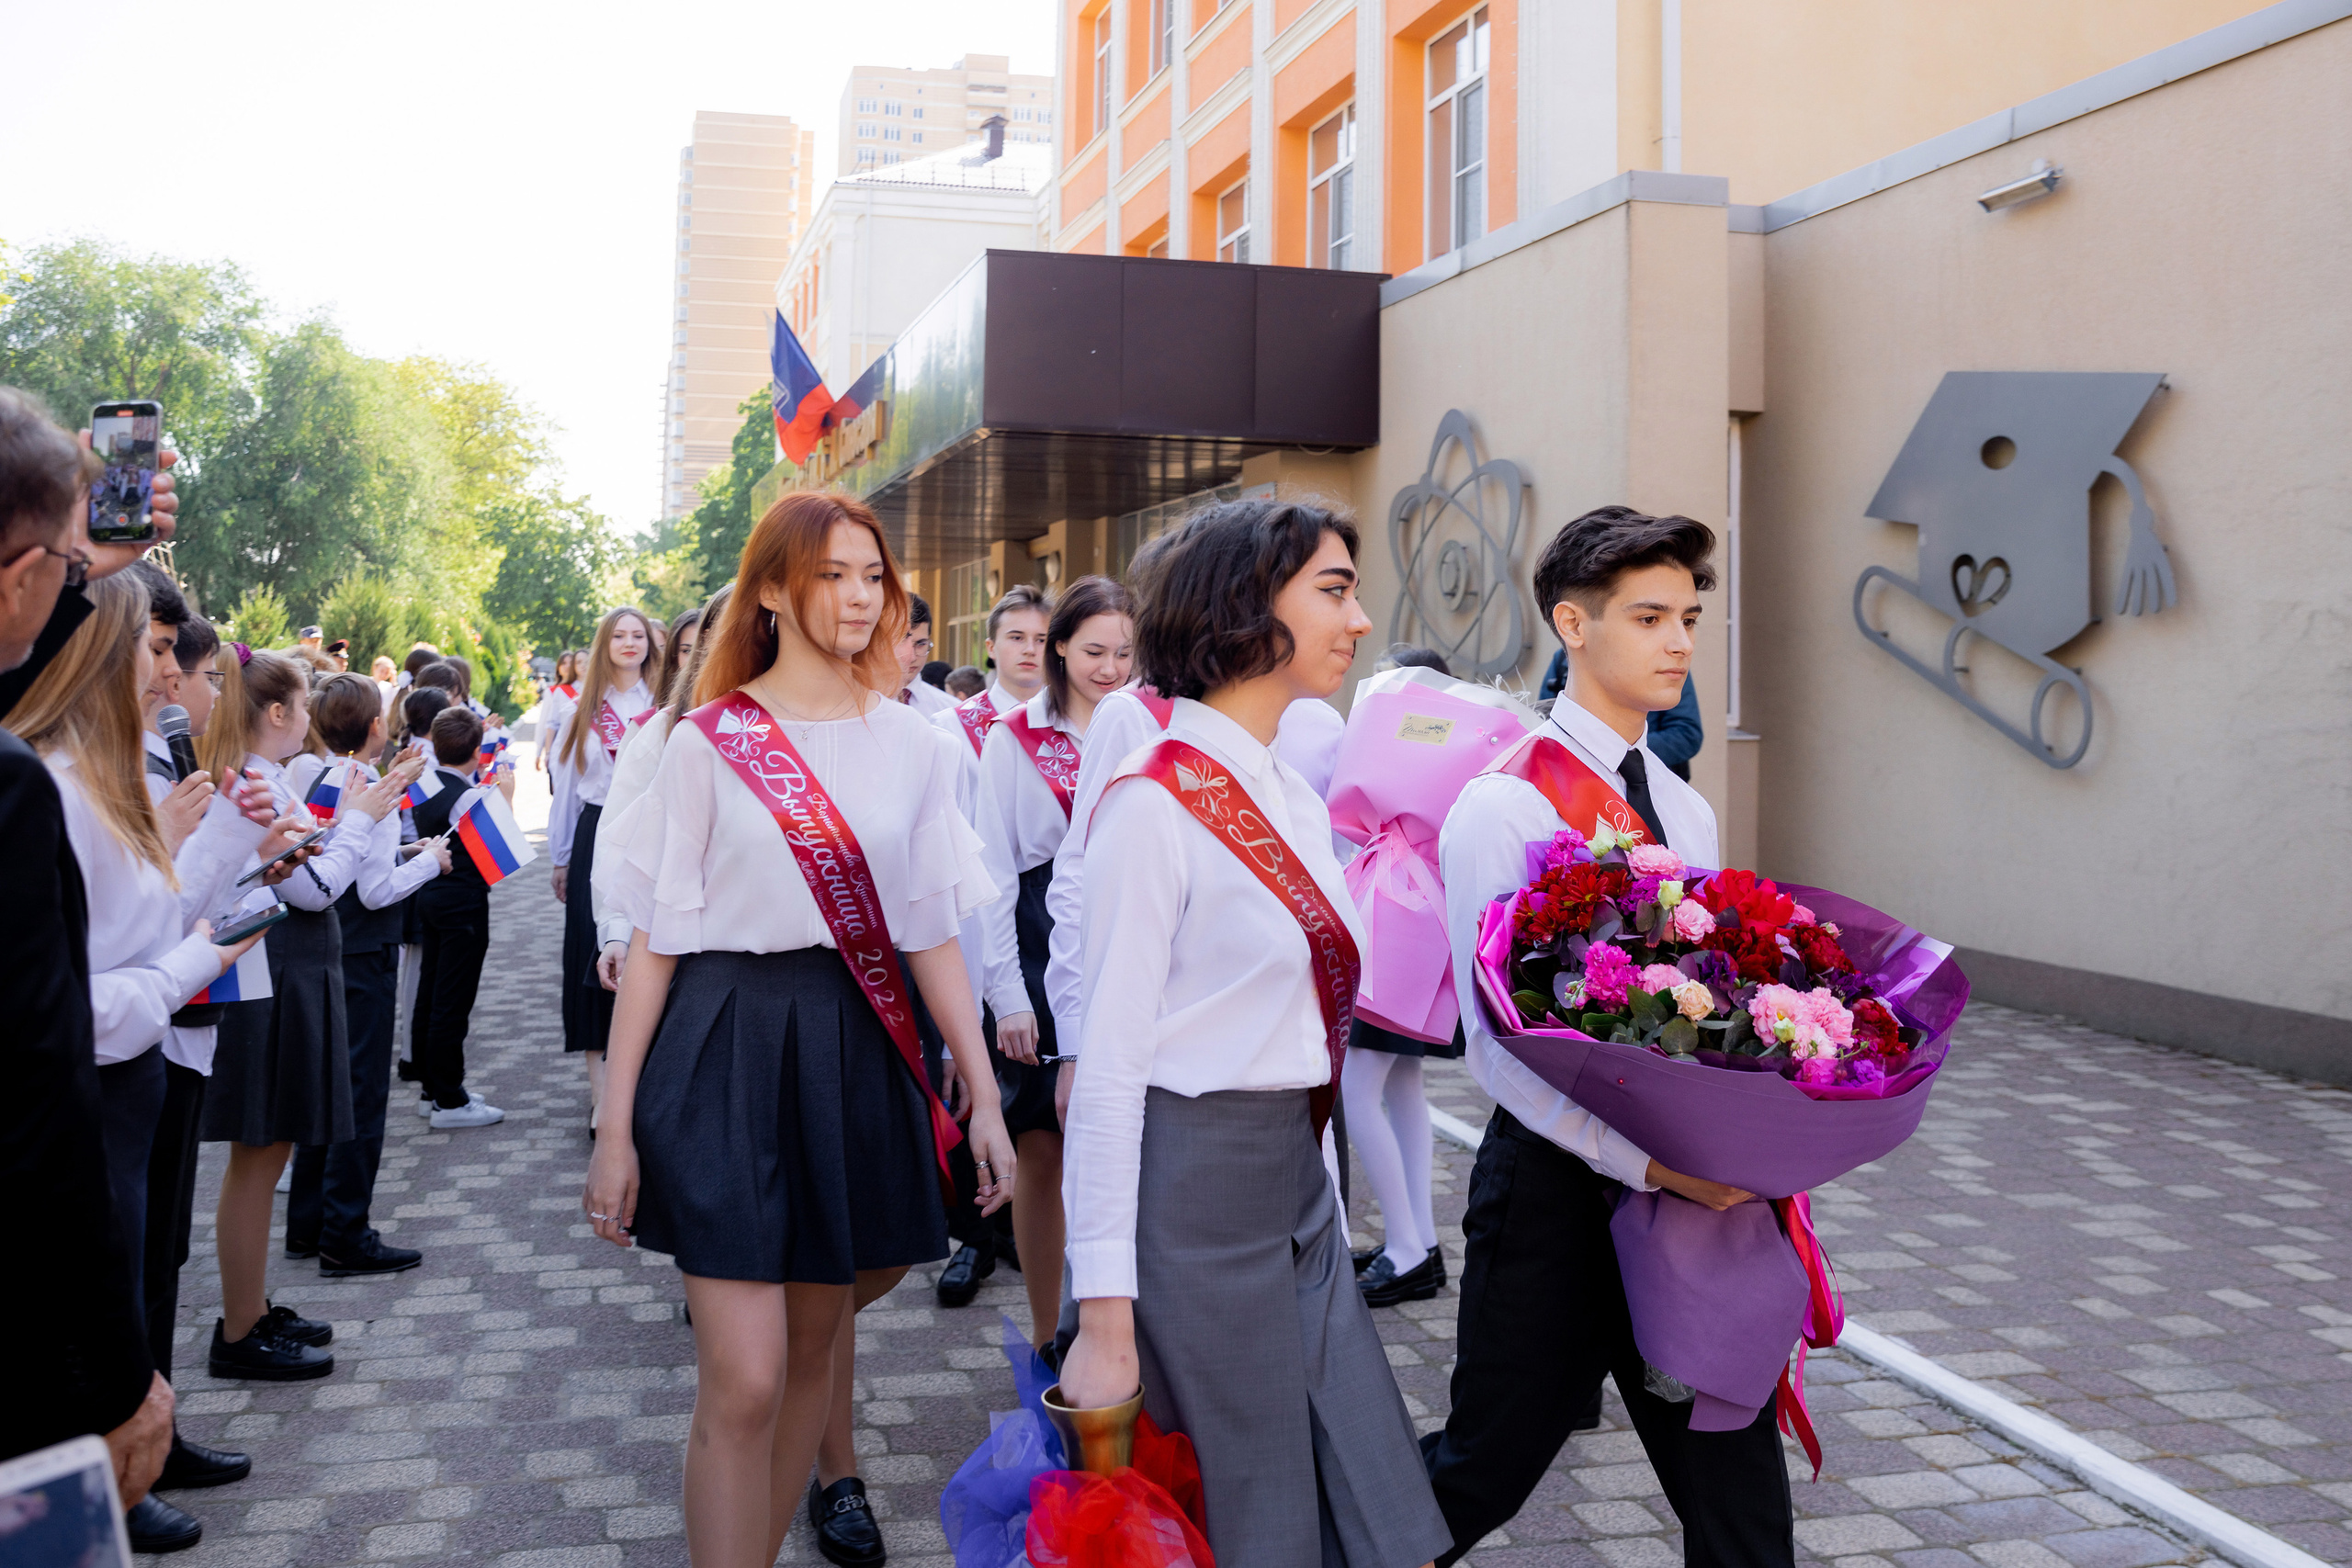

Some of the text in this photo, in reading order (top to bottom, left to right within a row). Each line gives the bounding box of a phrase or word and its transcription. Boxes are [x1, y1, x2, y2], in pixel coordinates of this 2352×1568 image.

[750, 750, 866, 941] Выпускница
[856, 948, 904, 1027] 2022
[1227, 809, 1351, 1049] Выпускница
